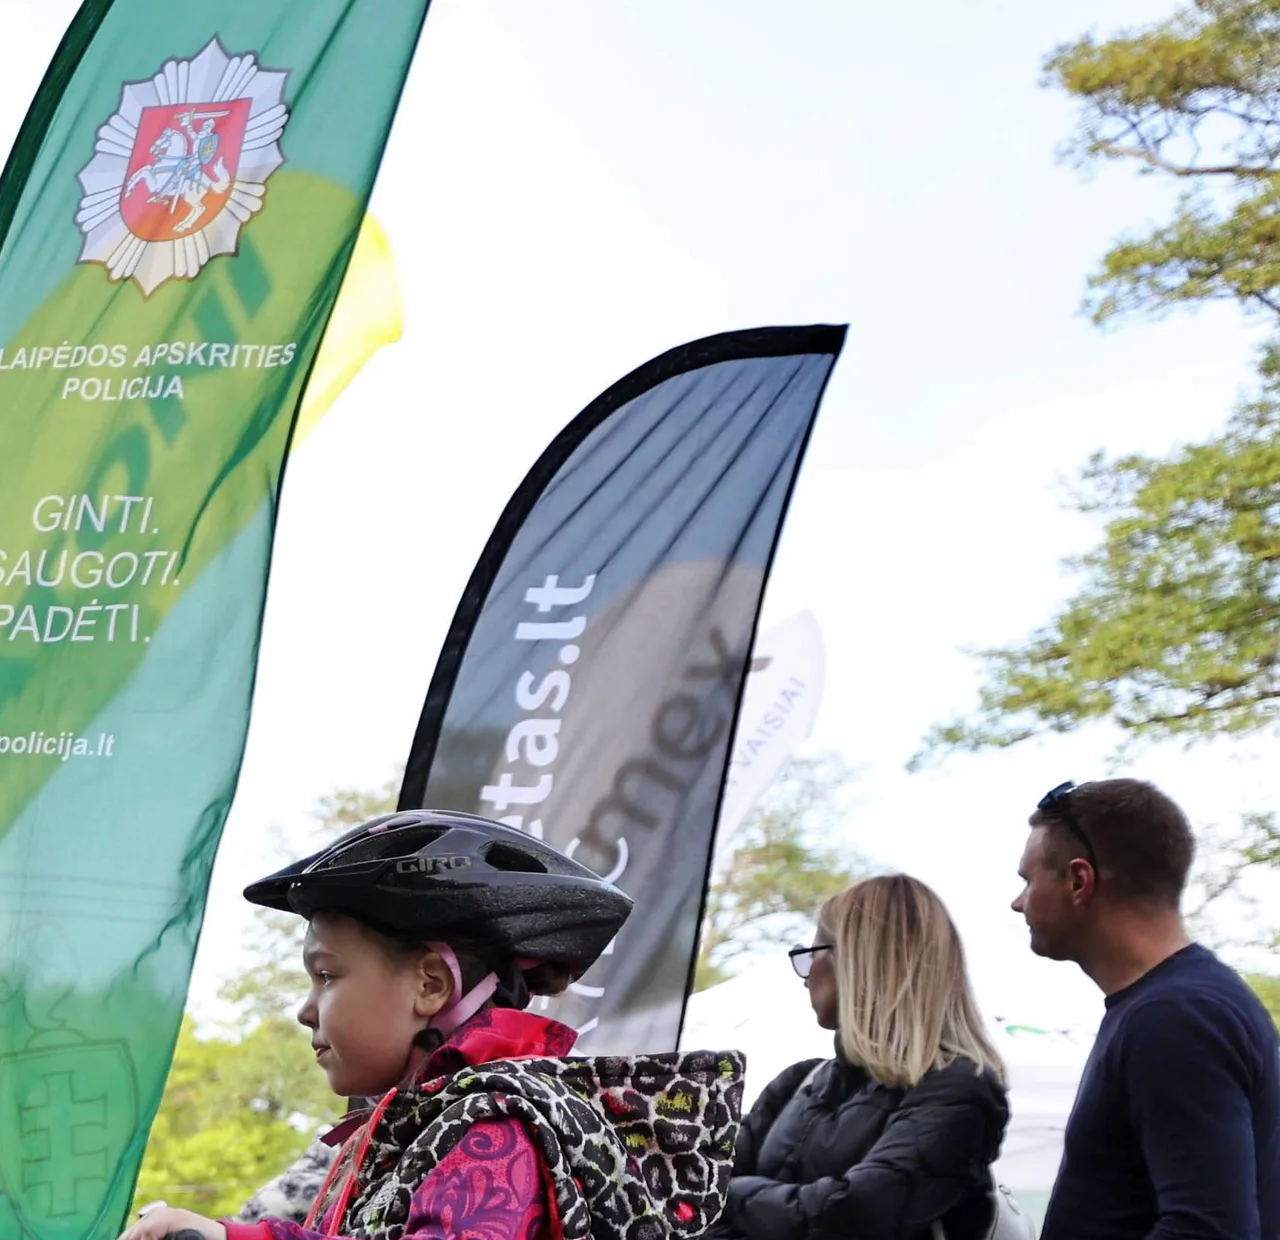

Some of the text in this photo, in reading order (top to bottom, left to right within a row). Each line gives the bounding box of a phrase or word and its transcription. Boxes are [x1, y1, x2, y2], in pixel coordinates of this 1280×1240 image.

[133, 342, 297, 370] APSKRITIES
[61, 376, 185, 401] POLICIJA
[32, 494, 160, 534] GINTI.
[396, 856, 471, 874] GIRO
